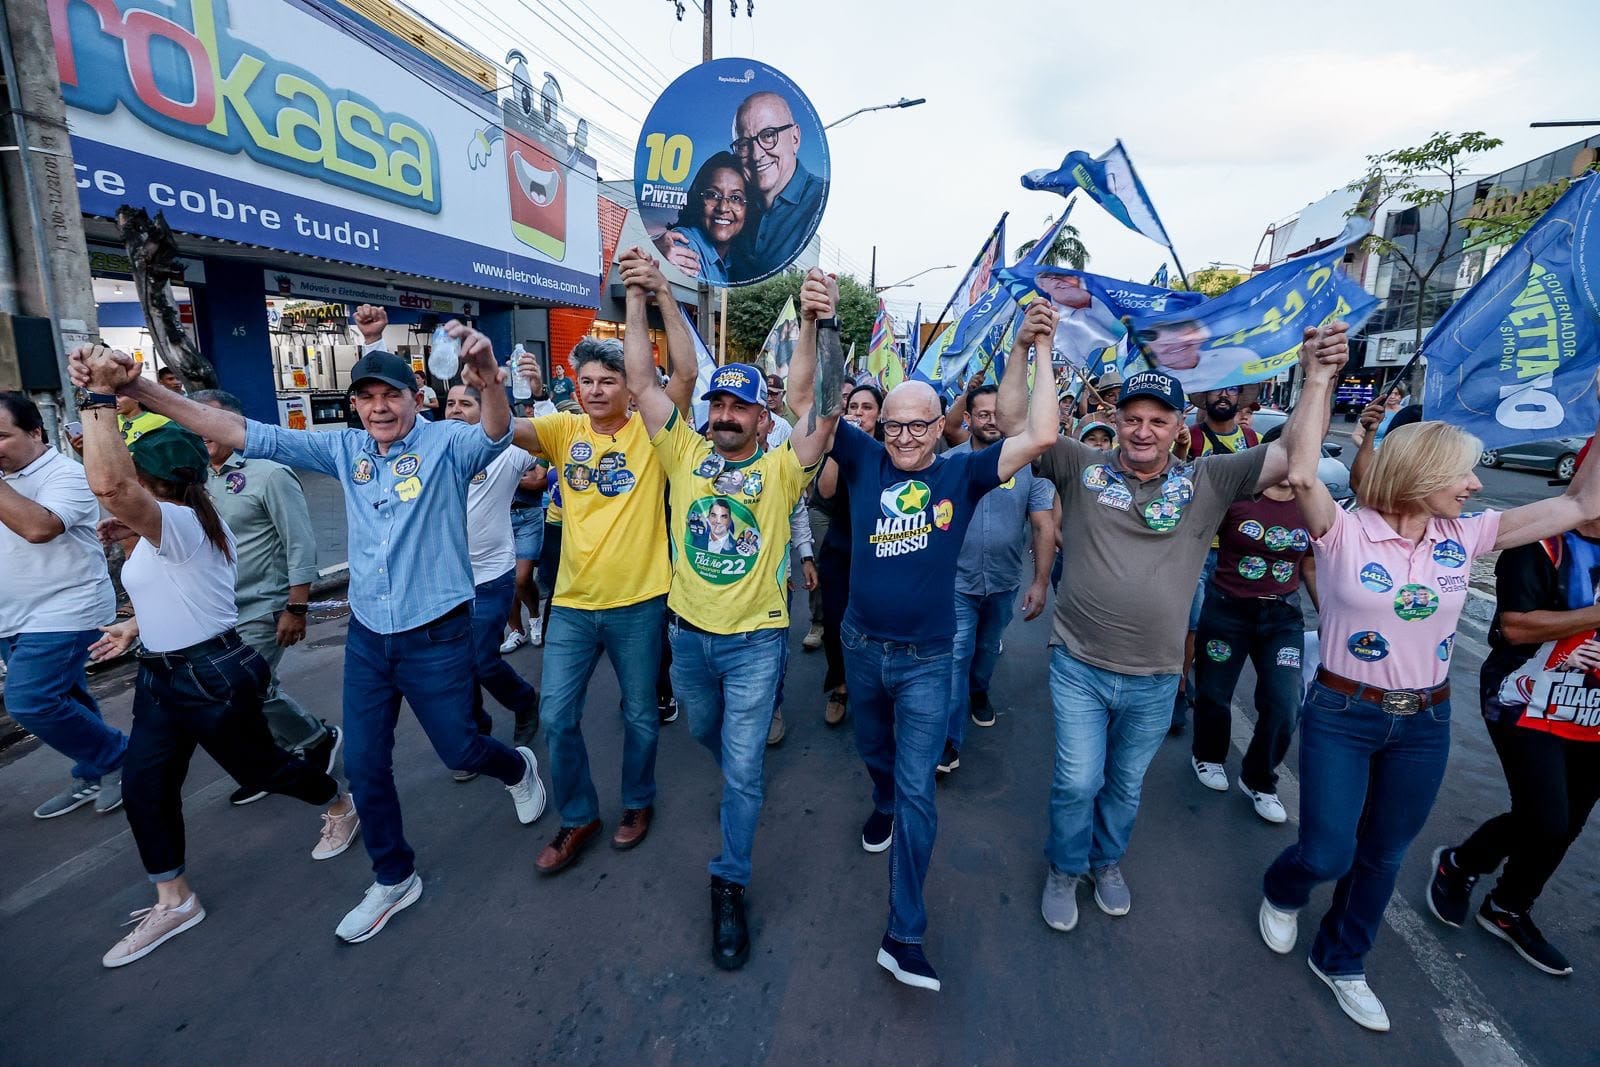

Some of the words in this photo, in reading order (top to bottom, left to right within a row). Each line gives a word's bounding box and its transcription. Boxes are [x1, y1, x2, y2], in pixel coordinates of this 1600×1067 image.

[645, 132, 694, 184] 10
[641, 183, 688, 206] PIVETTA
[149, 181, 281, 230] cobre
[294, 212, 380, 251] tudo!
[472, 261, 591, 296] www.eletrokasa.com.br
[1547, 272, 1577, 358] GOVERNADOR
[1499, 322, 1516, 372] SIMONA
[716, 378, 743, 388] 2026
[1128, 372, 1173, 387] Dilmar
[871, 526, 929, 542] #FAZIMENTO
[875, 511, 927, 536] MATO
[875, 533, 928, 558] GROSSO
[721, 558, 746, 575] 22
